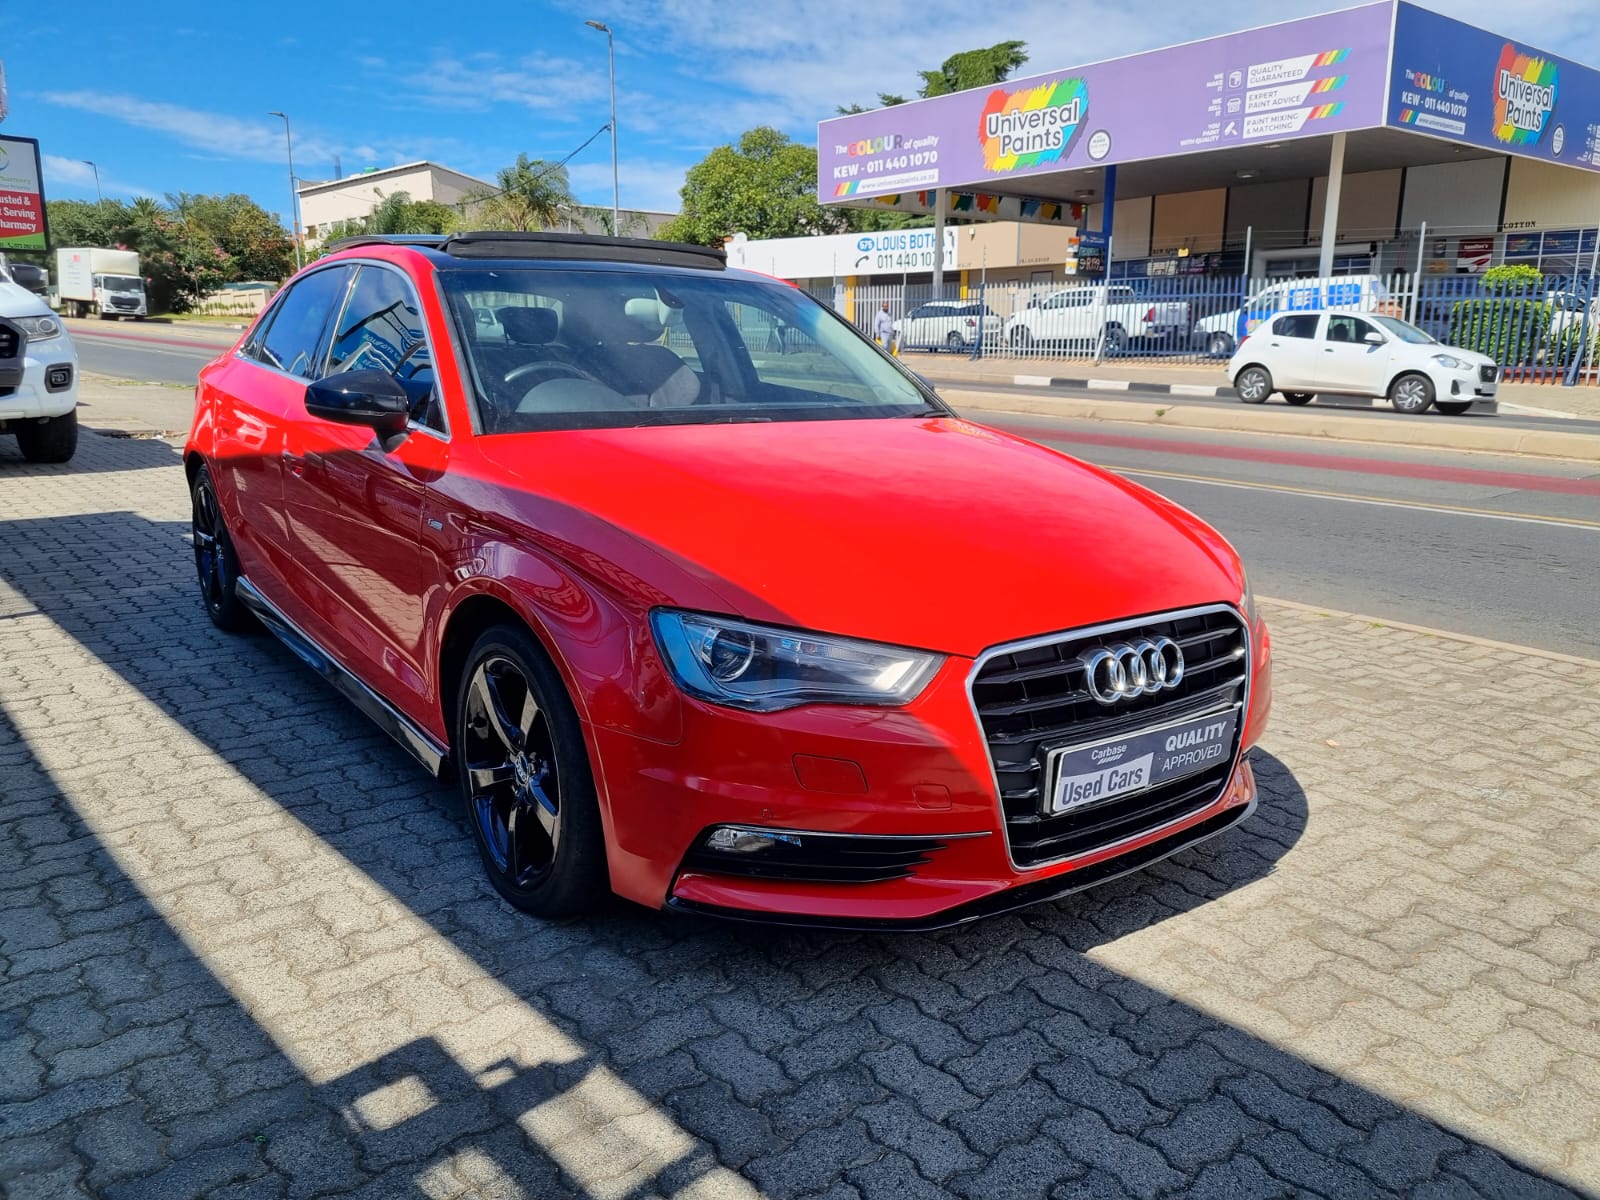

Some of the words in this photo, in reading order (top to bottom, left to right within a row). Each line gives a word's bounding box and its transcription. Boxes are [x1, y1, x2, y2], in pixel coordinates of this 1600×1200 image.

[1249, 69, 1303, 84] GUARANTEED
[1250, 64, 1283, 77] QUALITY
[1249, 90, 1278, 102] EXPERT
[1500, 71, 1554, 108] Universal
[1248, 100, 1271, 109] PAINT
[1272, 95, 1301, 105] ADVICE
[1401, 91, 1420, 106] KEW
[1424, 97, 1436, 110] 011
[1436, 101, 1450, 113] 440
[1451, 103, 1467, 118] 1070
[988, 100, 1078, 136] Universal
[1246, 117, 1269, 126] PAINT
[1271, 113, 1298, 121] MIXING
[1505, 100, 1542, 130] Paints
[1252, 122, 1293, 133] MATCHING
[835, 145, 848, 156] The
[848, 134, 902, 157] COLOUR
[903, 138, 914, 150] of
[913, 135, 939, 150] quality
[1001, 128, 1061, 155] Paints
[833, 163, 859, 179] KEW
[866, 159, 883, 174] 011
[886, 155, 907, 170] 440
[909, 150, 938, 167] 1070
[24, 196, 31, 206] &
[3, 207, 36, 221] Serving
[1503, 220, 1536, 229] COTTON
[876, 235, 906, 251] LOUIS
[910, 233, 945, 249] BOTH
[877, 254, 893, 269] 011
[896, 252, 918, 268] 440
[1165, 721, 1227, 752] QUALITY
[1091, 744, 1128, 761] Carbase
[1162, 743, 1223, 773] APPROVED
[1062, 774, 1103, 805] Used
[1107, 766, 1143, 792] Cars
